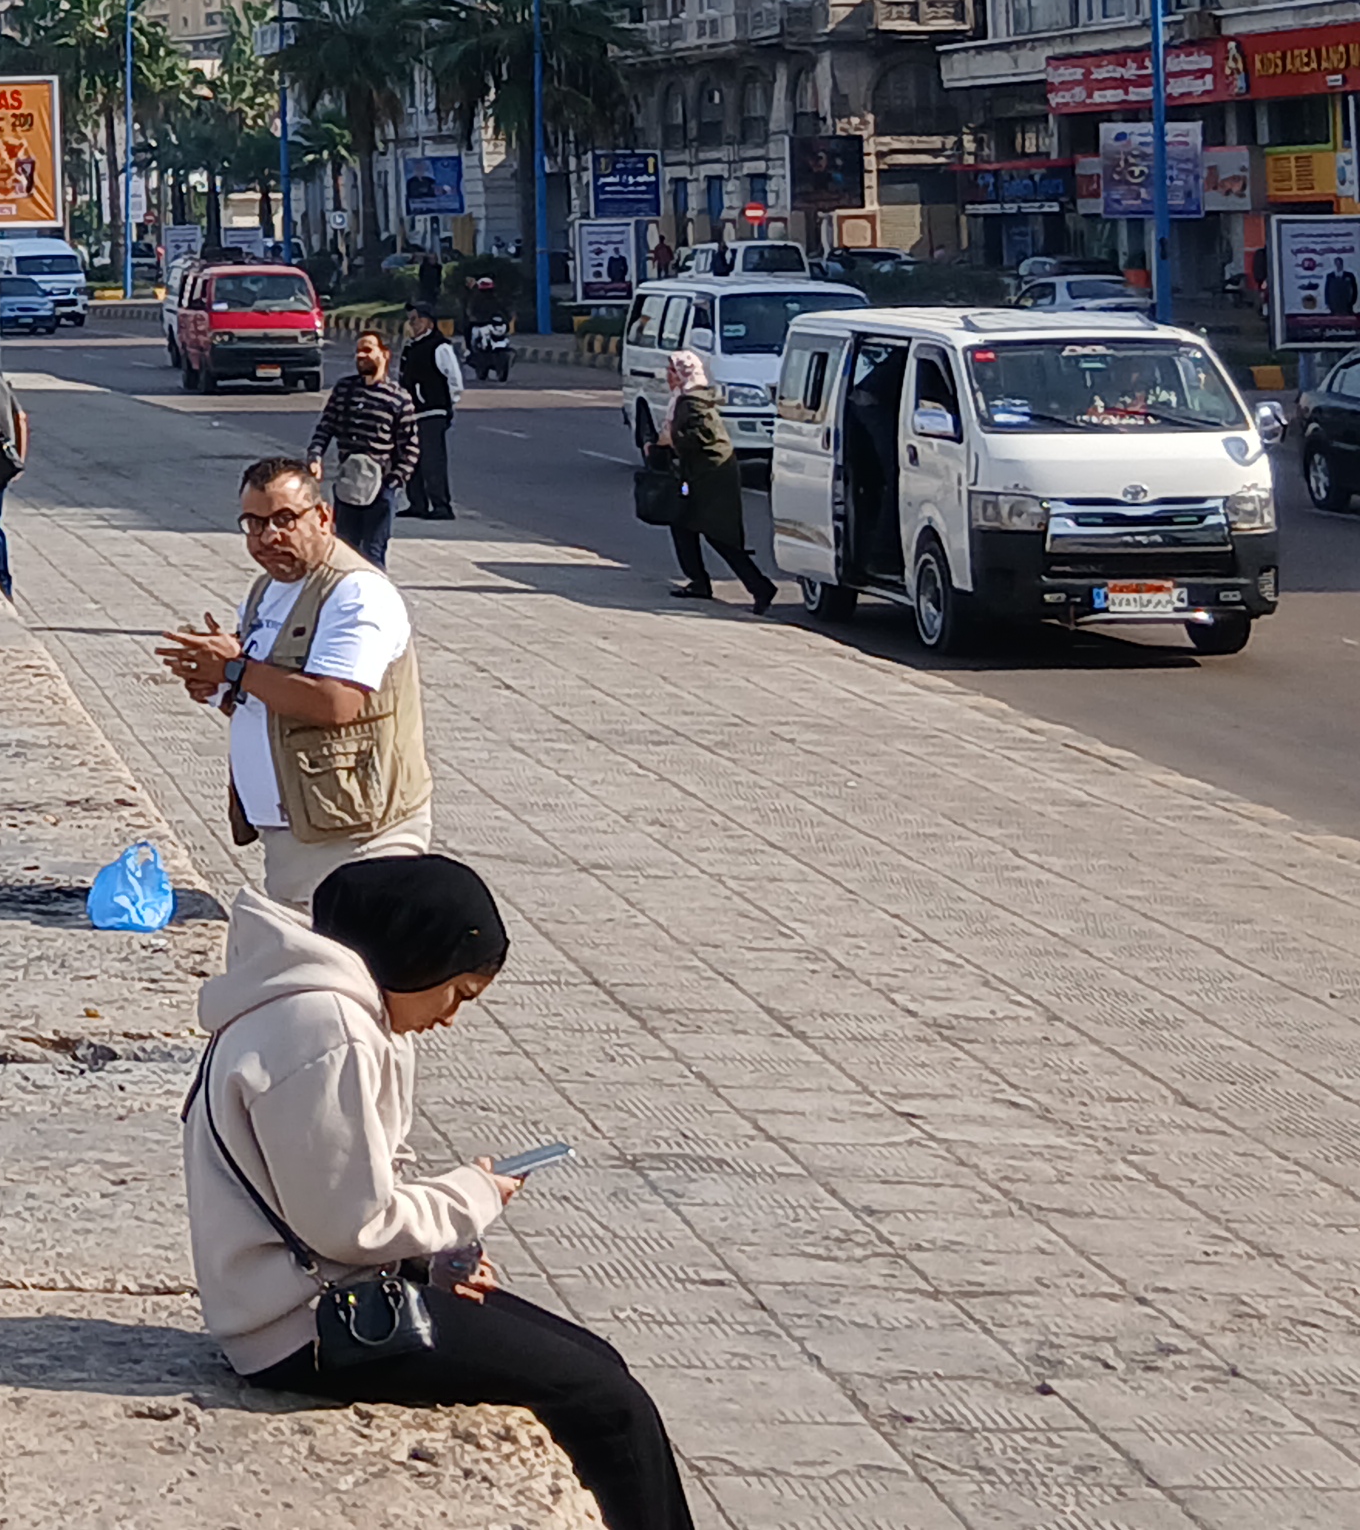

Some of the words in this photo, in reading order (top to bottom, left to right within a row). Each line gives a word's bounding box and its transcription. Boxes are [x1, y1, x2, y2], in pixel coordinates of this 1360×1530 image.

[1255, 51, 1282, 77] KIDS
[1286, 48, 1318, 74] AREA
[1321, 44, 1347, 71] AND
